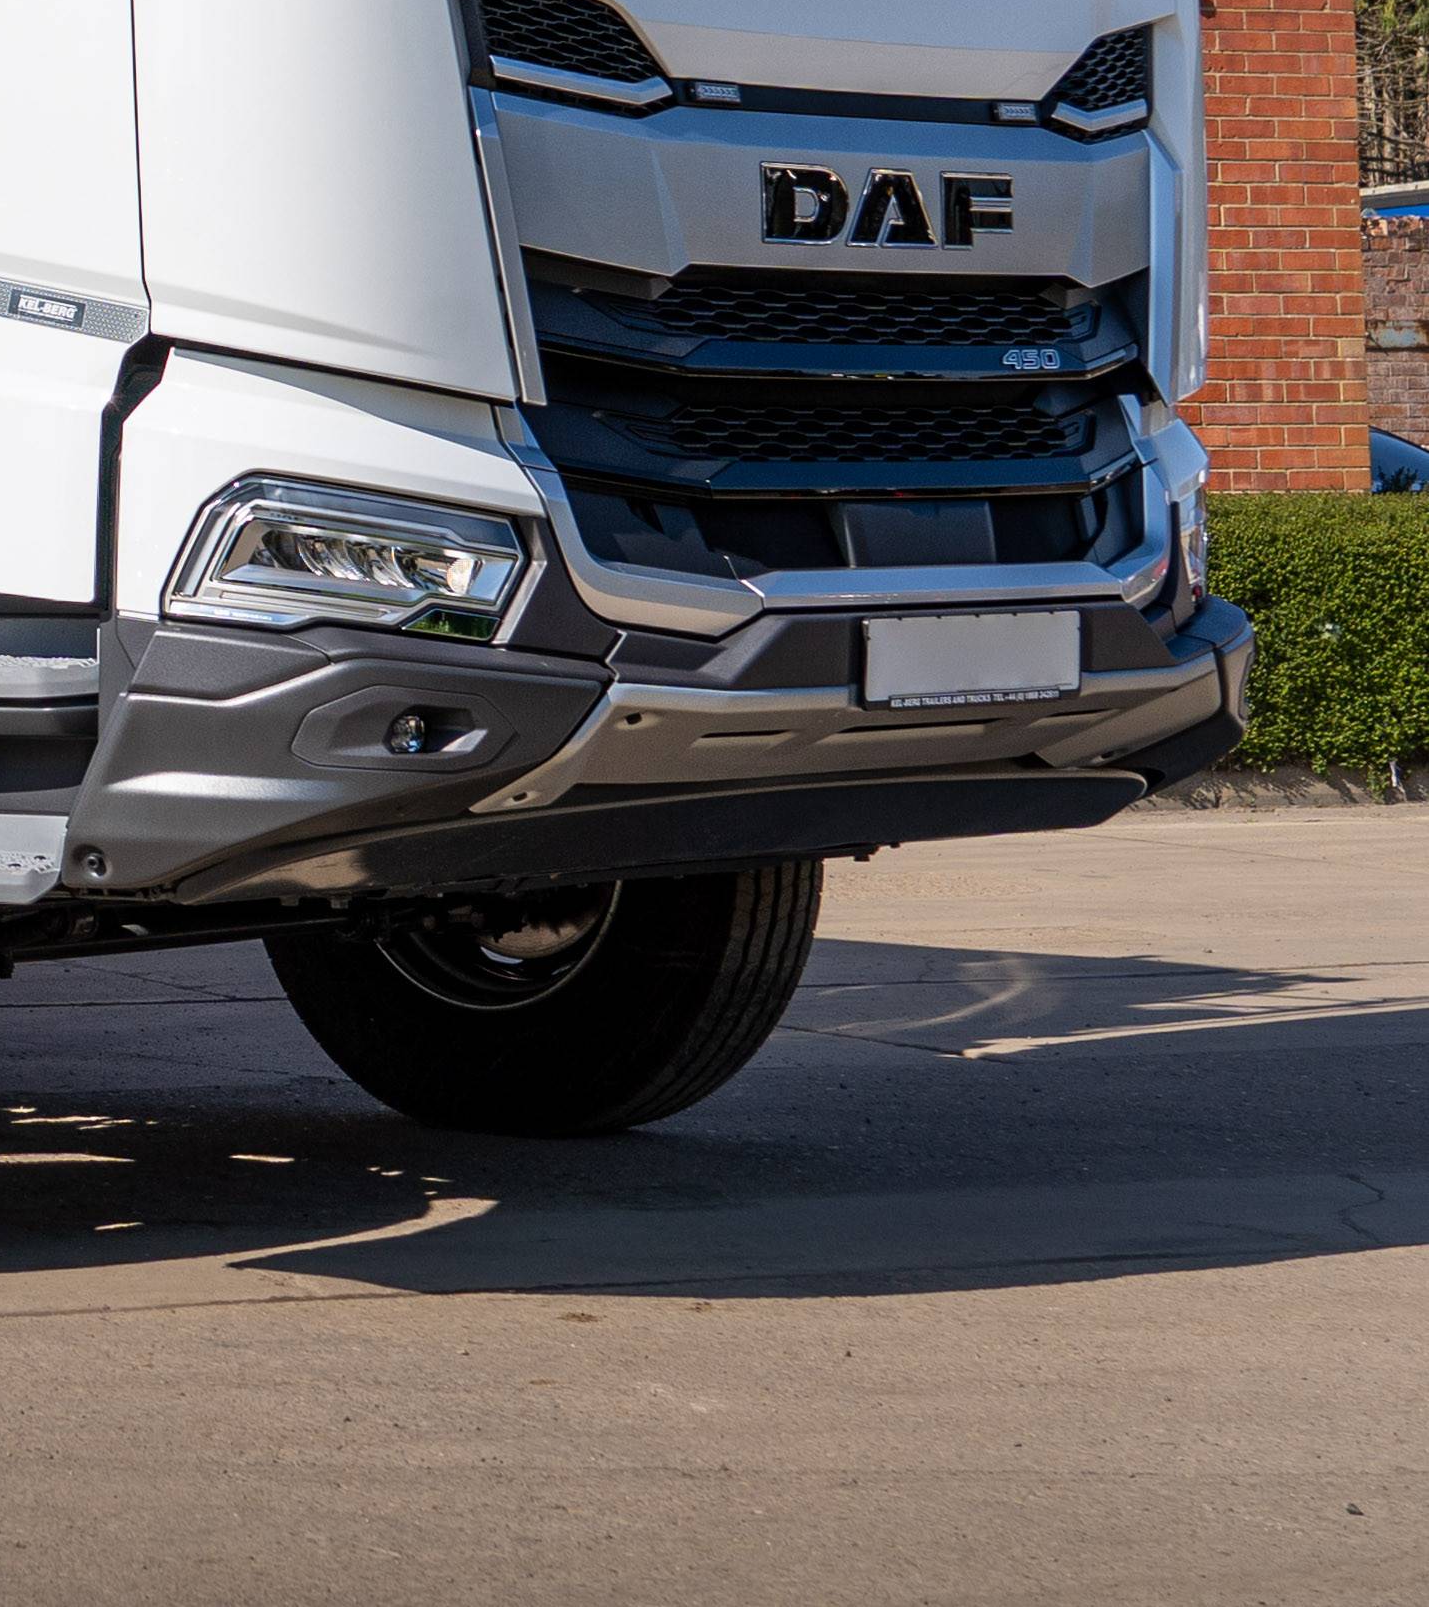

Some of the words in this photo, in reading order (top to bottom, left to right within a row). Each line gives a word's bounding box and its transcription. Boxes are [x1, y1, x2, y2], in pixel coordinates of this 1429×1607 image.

[761, 162, 1014, 250] DAF
[18, 296, 78, 319] KEL-BERG
[1003, 349, 1060, 369] 450
